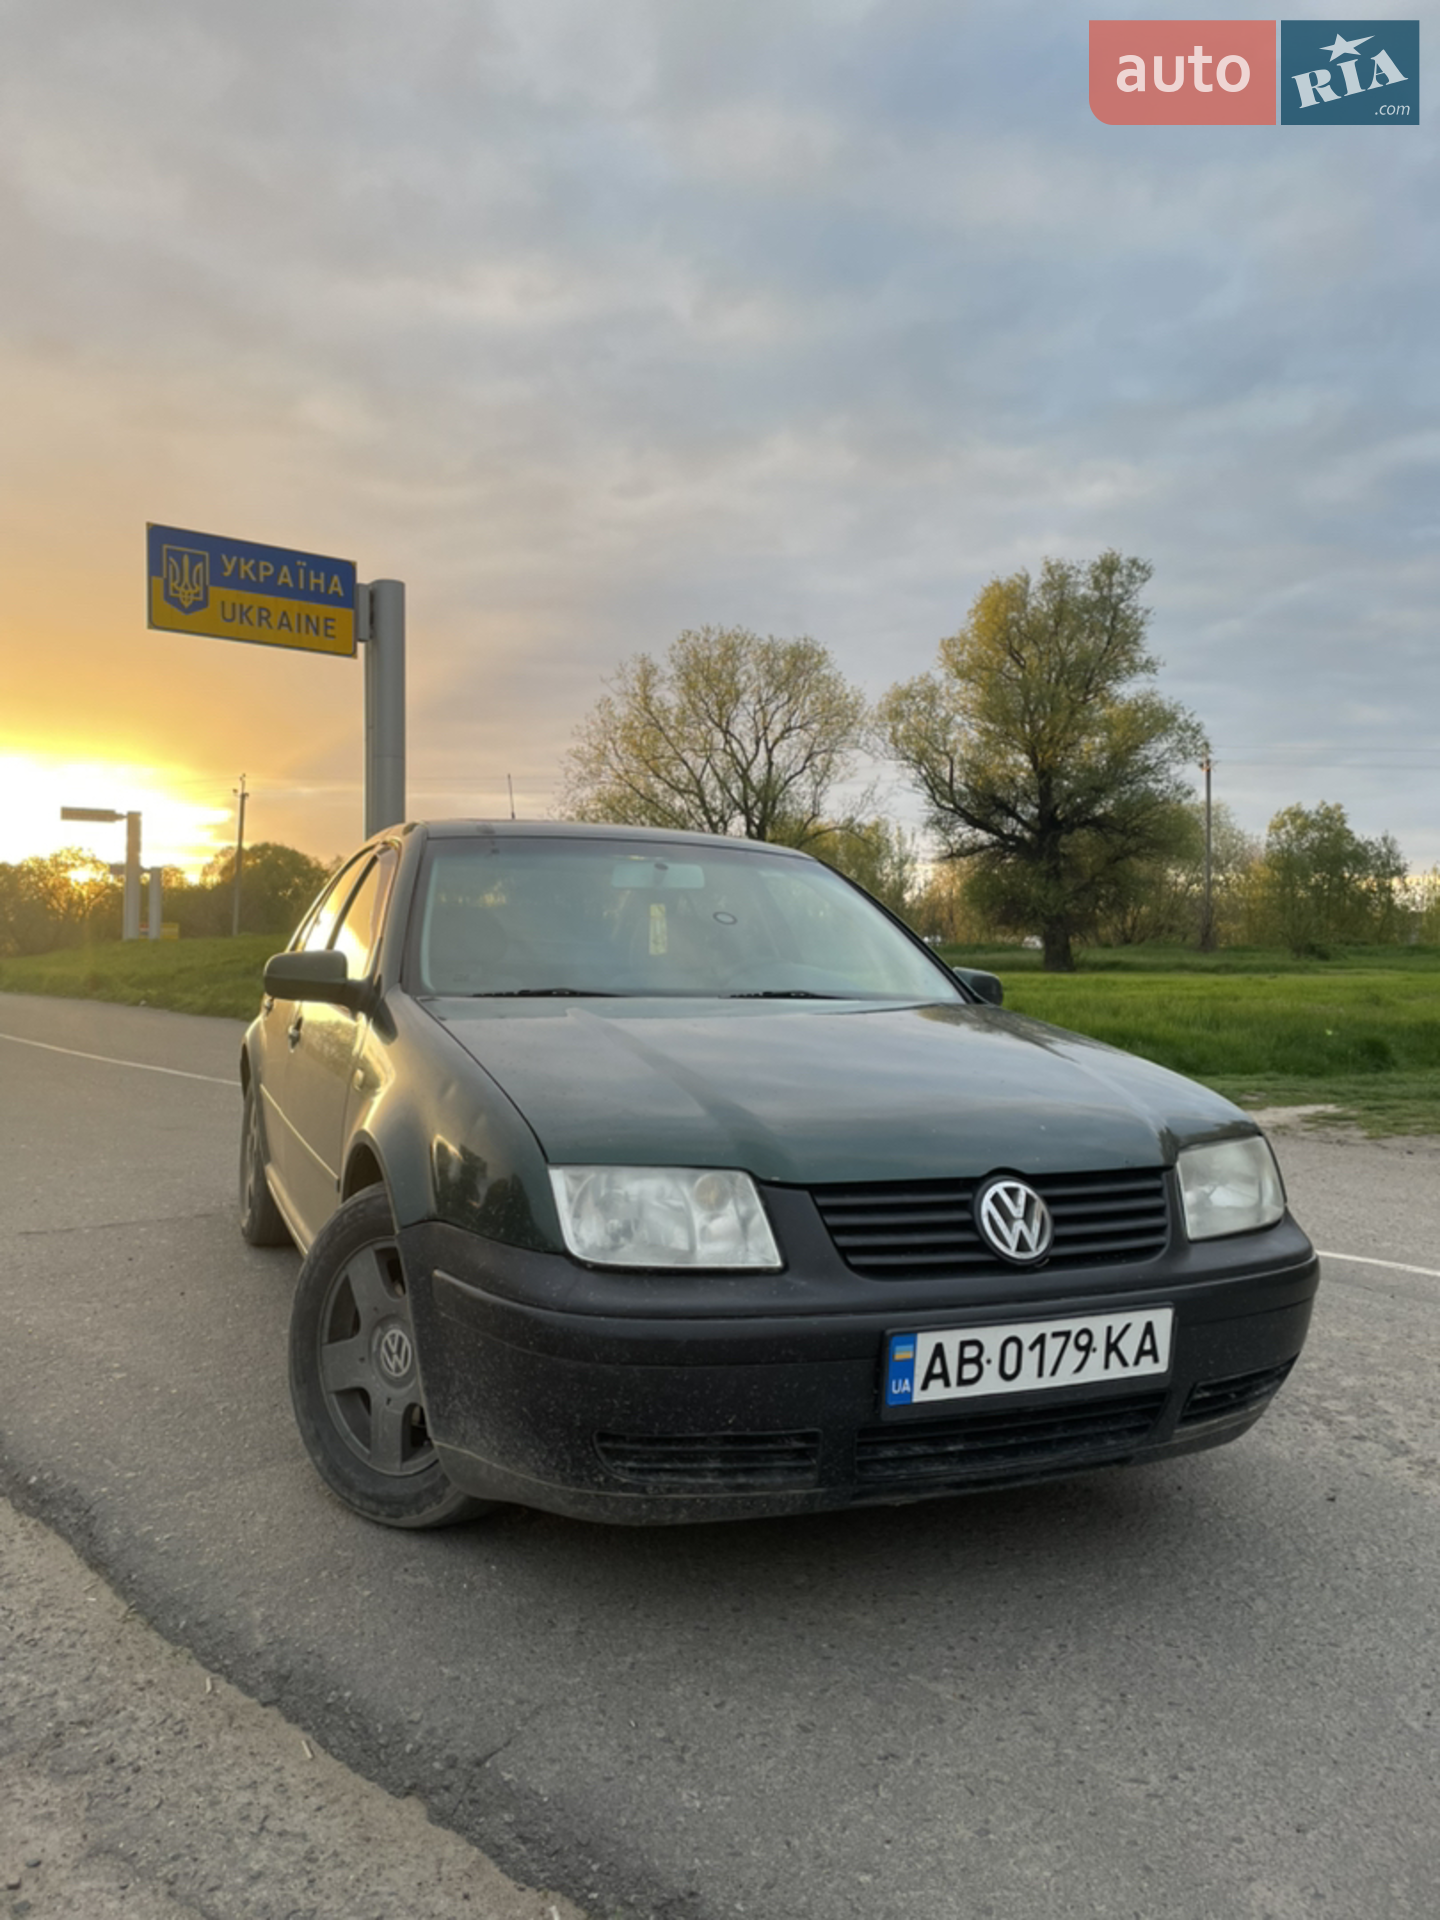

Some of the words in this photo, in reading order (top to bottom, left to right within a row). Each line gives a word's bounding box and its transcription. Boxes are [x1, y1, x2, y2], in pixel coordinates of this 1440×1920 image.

[221, 553, 344, 597] УКРАЇНА
[220, 600, 336, 640] UKRAINE
[892, 1378, 911, 1394] UA
